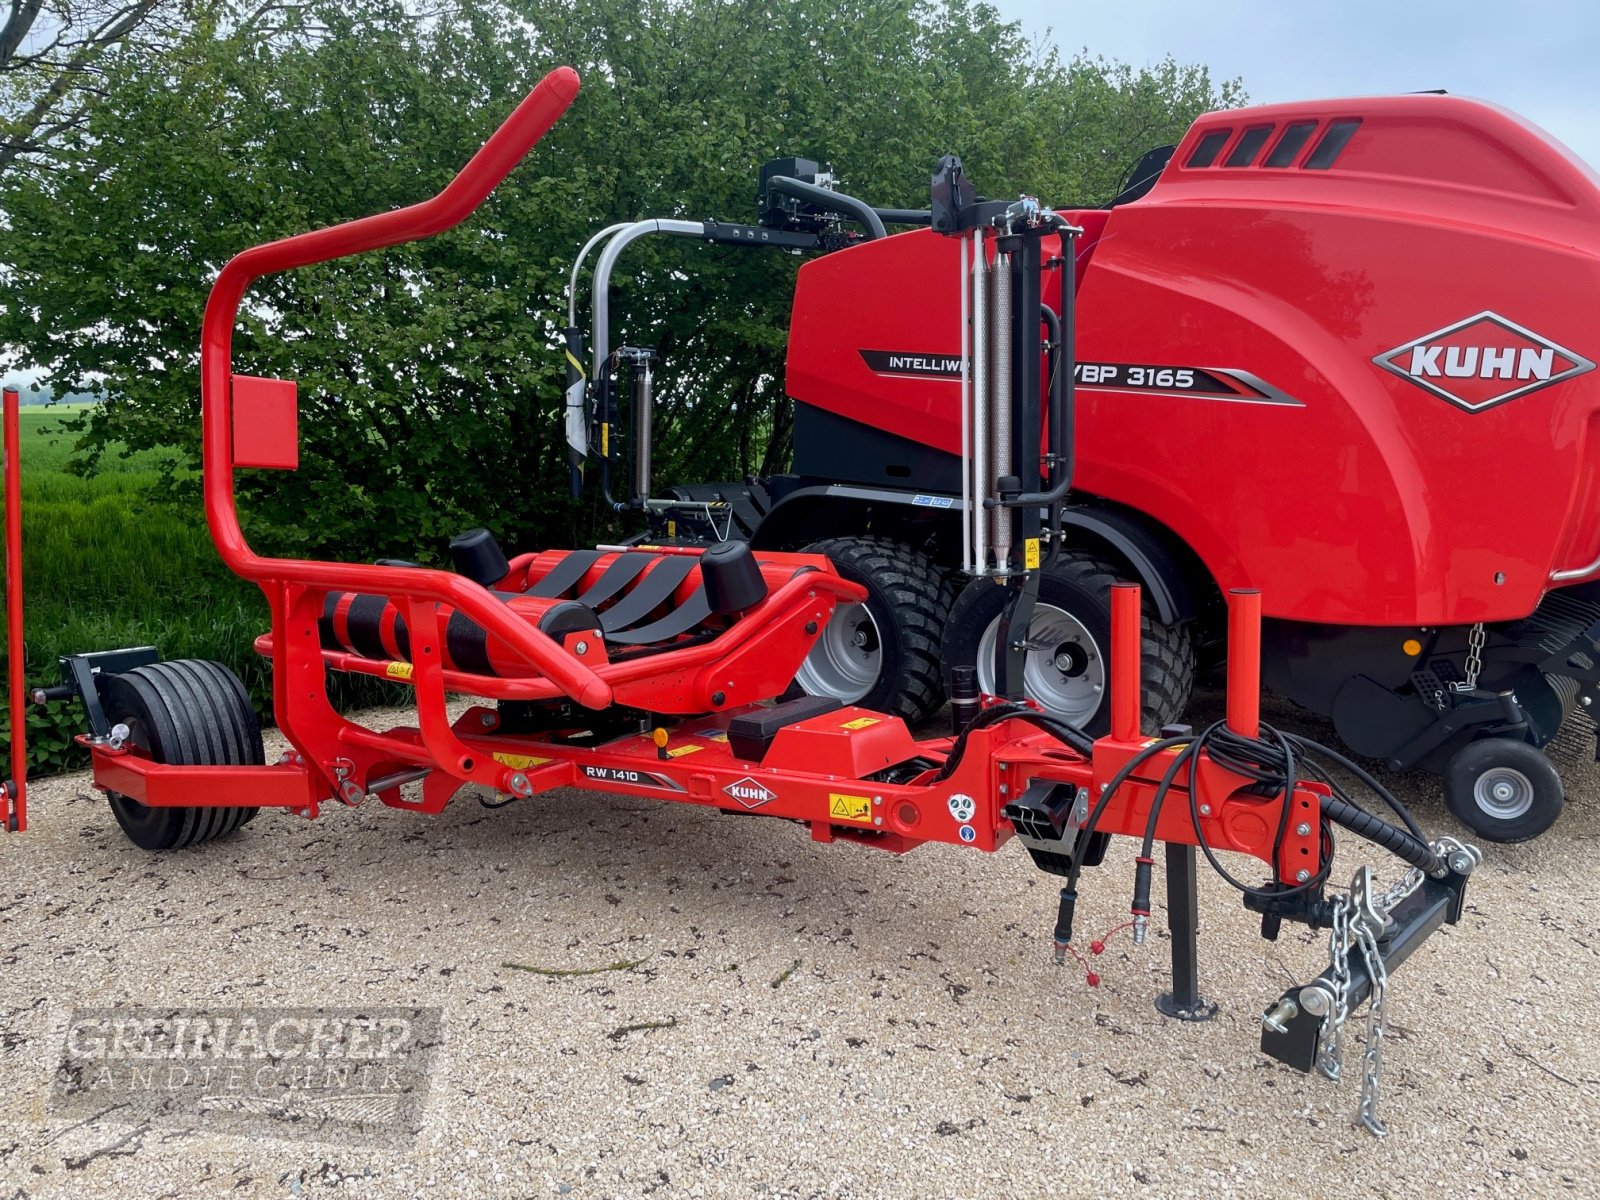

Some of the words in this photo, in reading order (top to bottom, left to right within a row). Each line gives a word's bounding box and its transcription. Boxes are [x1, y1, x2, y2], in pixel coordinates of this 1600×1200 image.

[1411, 346, 1554, 380] KUHN
[1127, 367, 1194, 388] 3165
[586, 766, 607, 778] RW
[611, 770, 638, 781] 1410
[732, 785, 768, 800] KUHN
